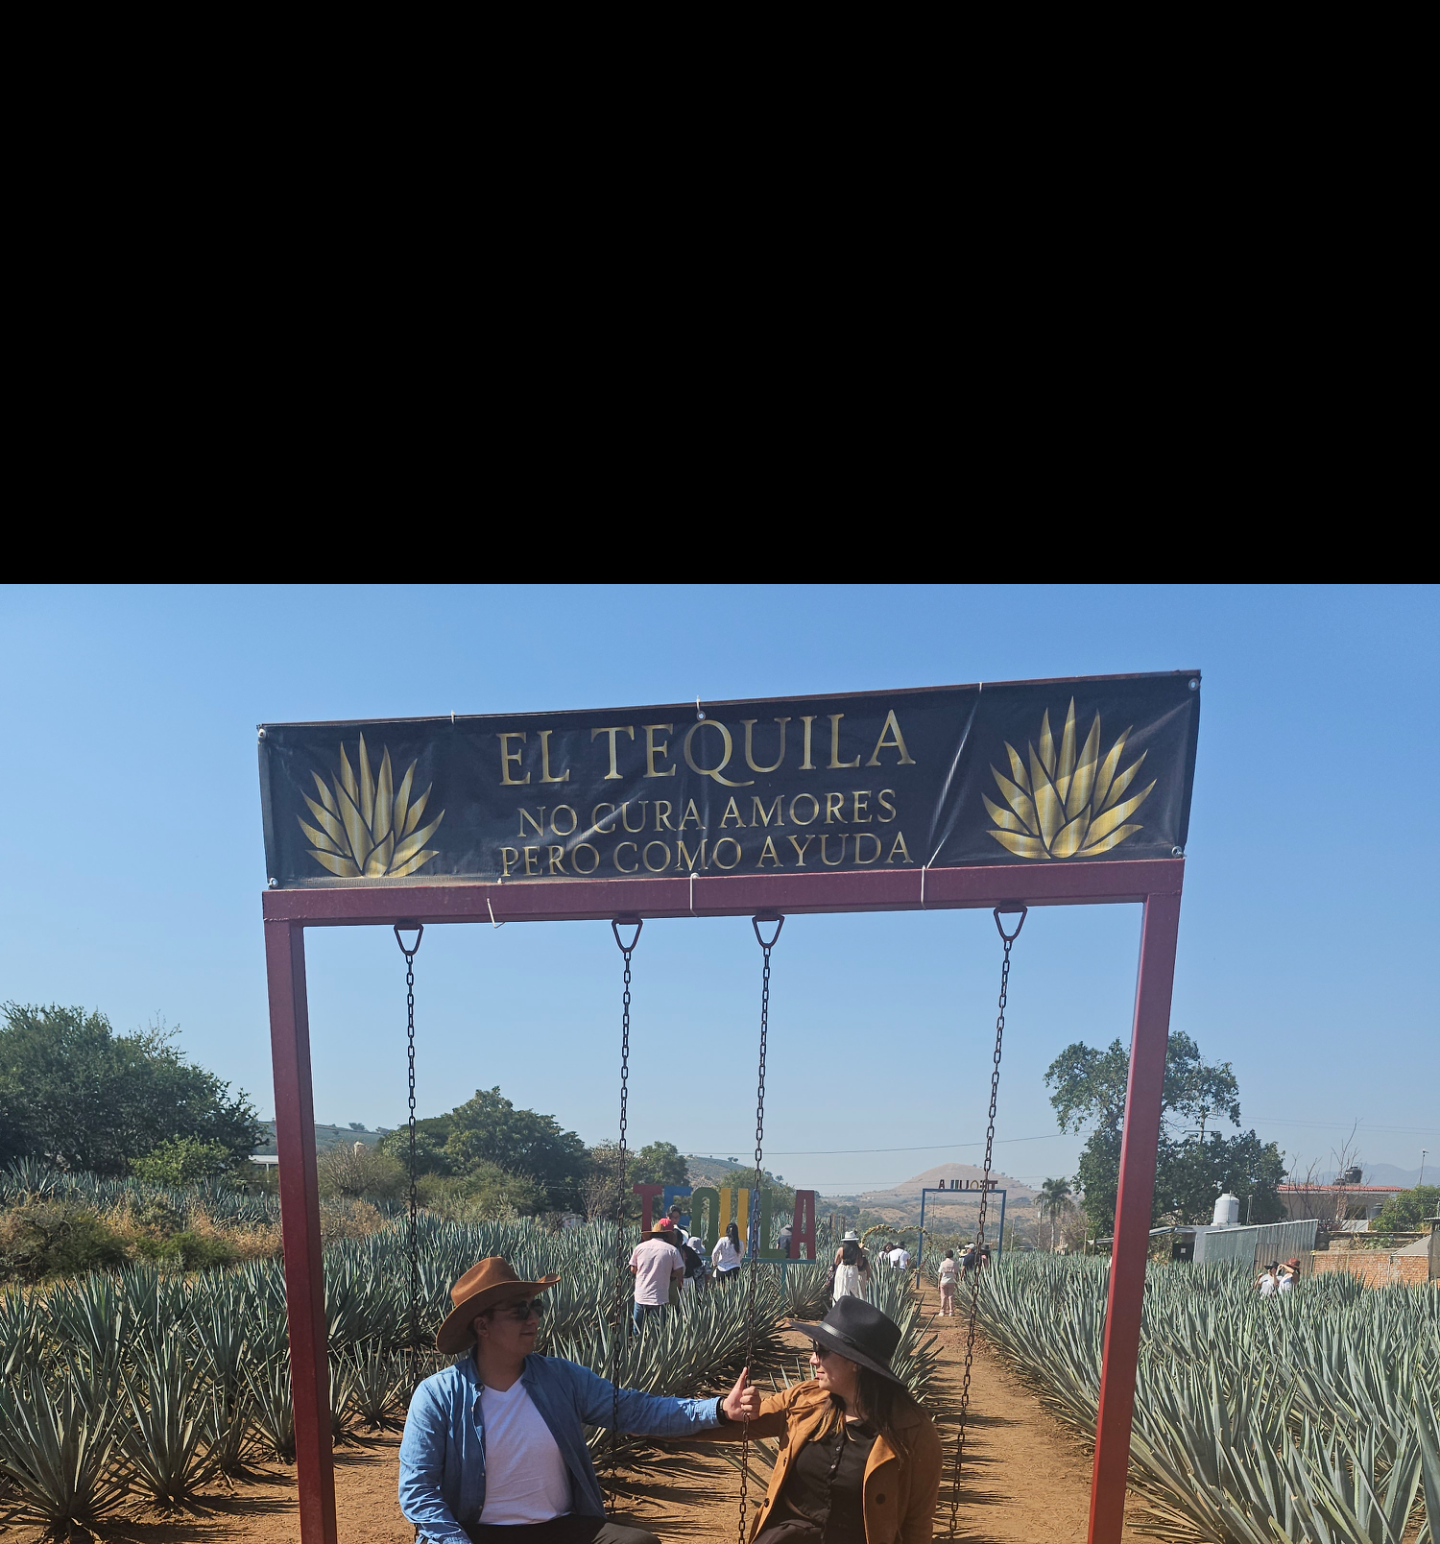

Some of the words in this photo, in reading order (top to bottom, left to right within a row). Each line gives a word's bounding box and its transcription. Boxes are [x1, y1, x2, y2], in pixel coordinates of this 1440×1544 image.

[496, 730, 570, 786] EL
[590, 709, 916, 787] TEQUILA
[517, 804, 578, 838] NO
[591, 797, 707, 833] CURA
[718, 789, 897, 830] AMORES
[499, 843, 600, 877] PERO
[613, 837, 742, 874] COMO
[755, 831, 914, 869] AYUDA
